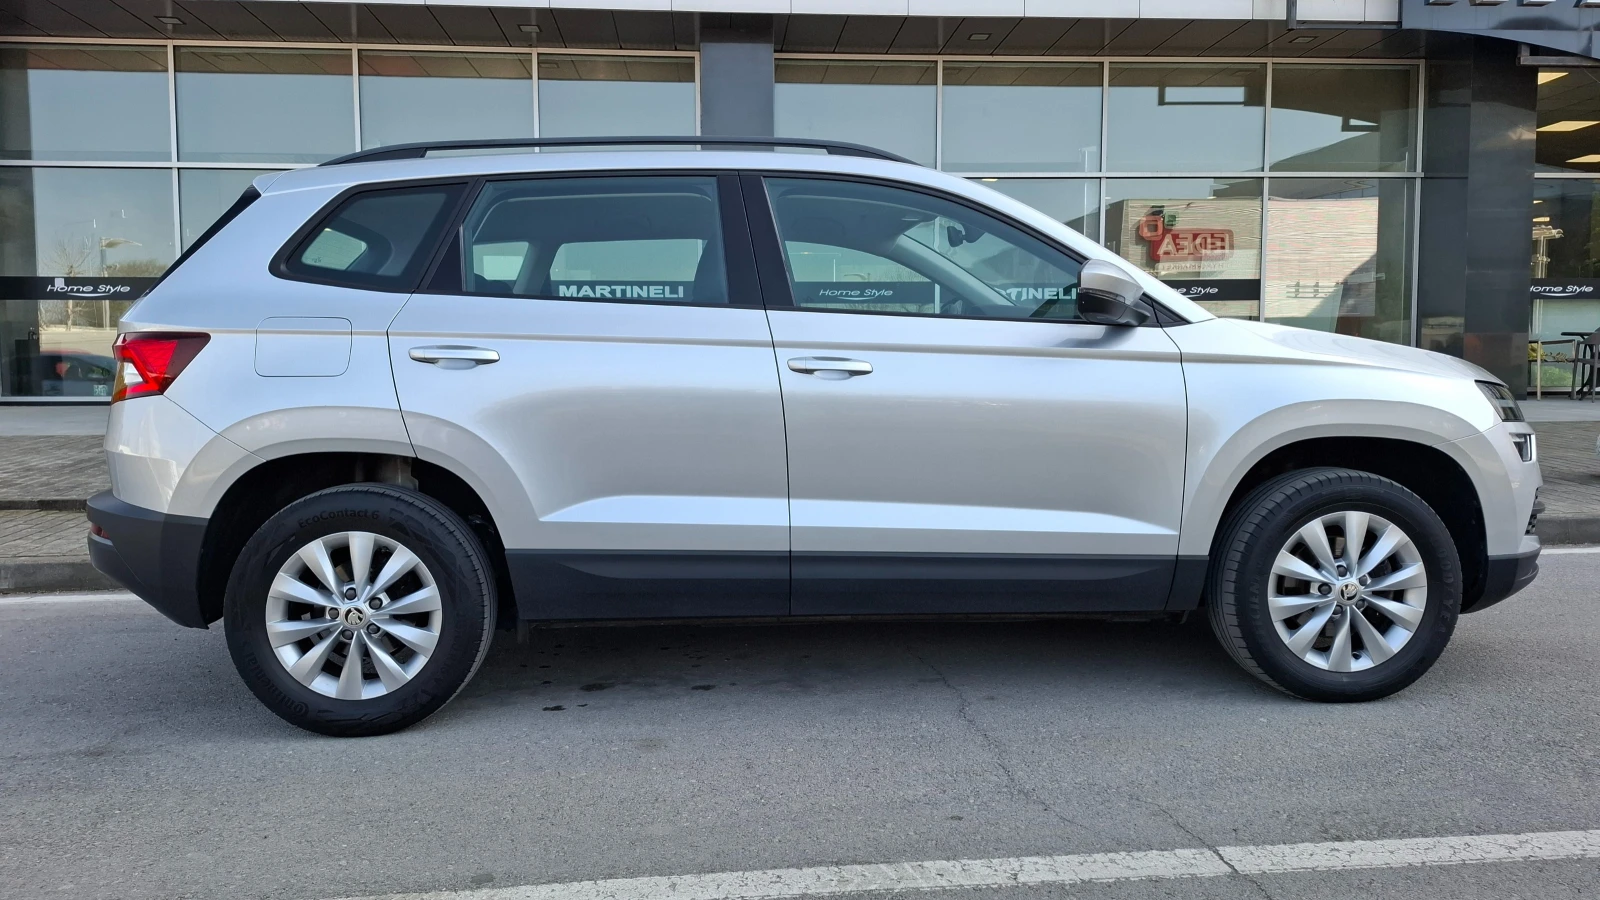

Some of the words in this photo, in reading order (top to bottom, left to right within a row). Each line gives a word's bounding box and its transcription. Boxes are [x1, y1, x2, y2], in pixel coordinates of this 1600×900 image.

[46, 284, 93, 293] Home
[97, 284, 131, 294] Style
[559, 285, 684, 298] MARTINELI
[863, 288, 893, 298] Style
[1189, 286, 1218, 295] Style
[1566, 285, 1594, 294] Style
[298, 508, 369, 529] EcoContact
[371, 510, 380, 523] 6
